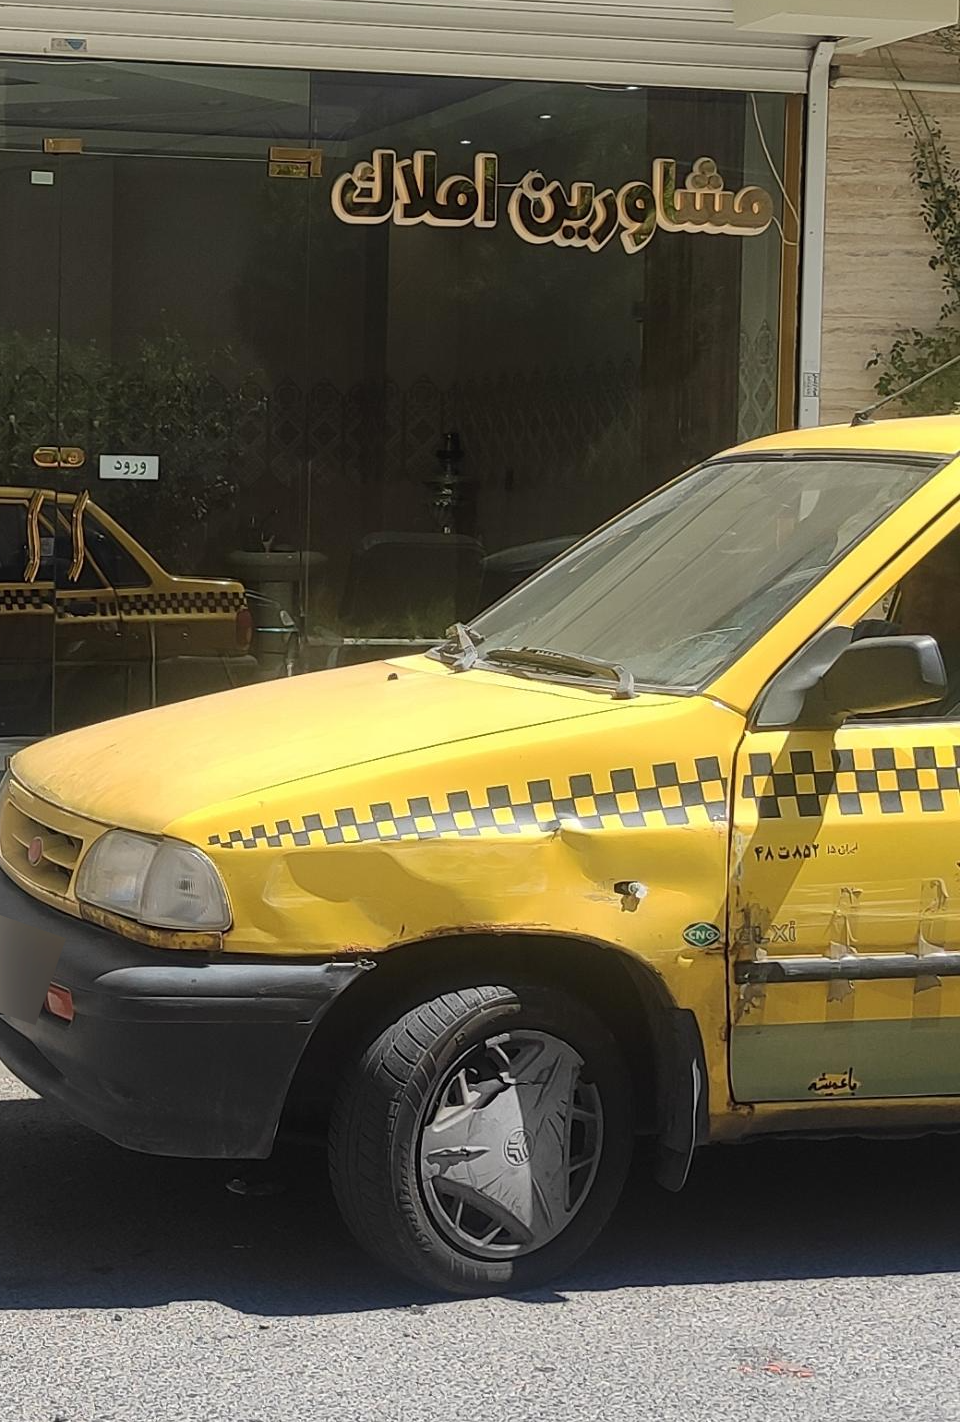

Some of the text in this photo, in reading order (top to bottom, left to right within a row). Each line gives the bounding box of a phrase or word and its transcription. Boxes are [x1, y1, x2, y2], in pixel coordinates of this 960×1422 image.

[508, 155, 774, 254] مشاورین
[113, 460, 147, 475] ورود
[688, 928, 716, 940] CNG
